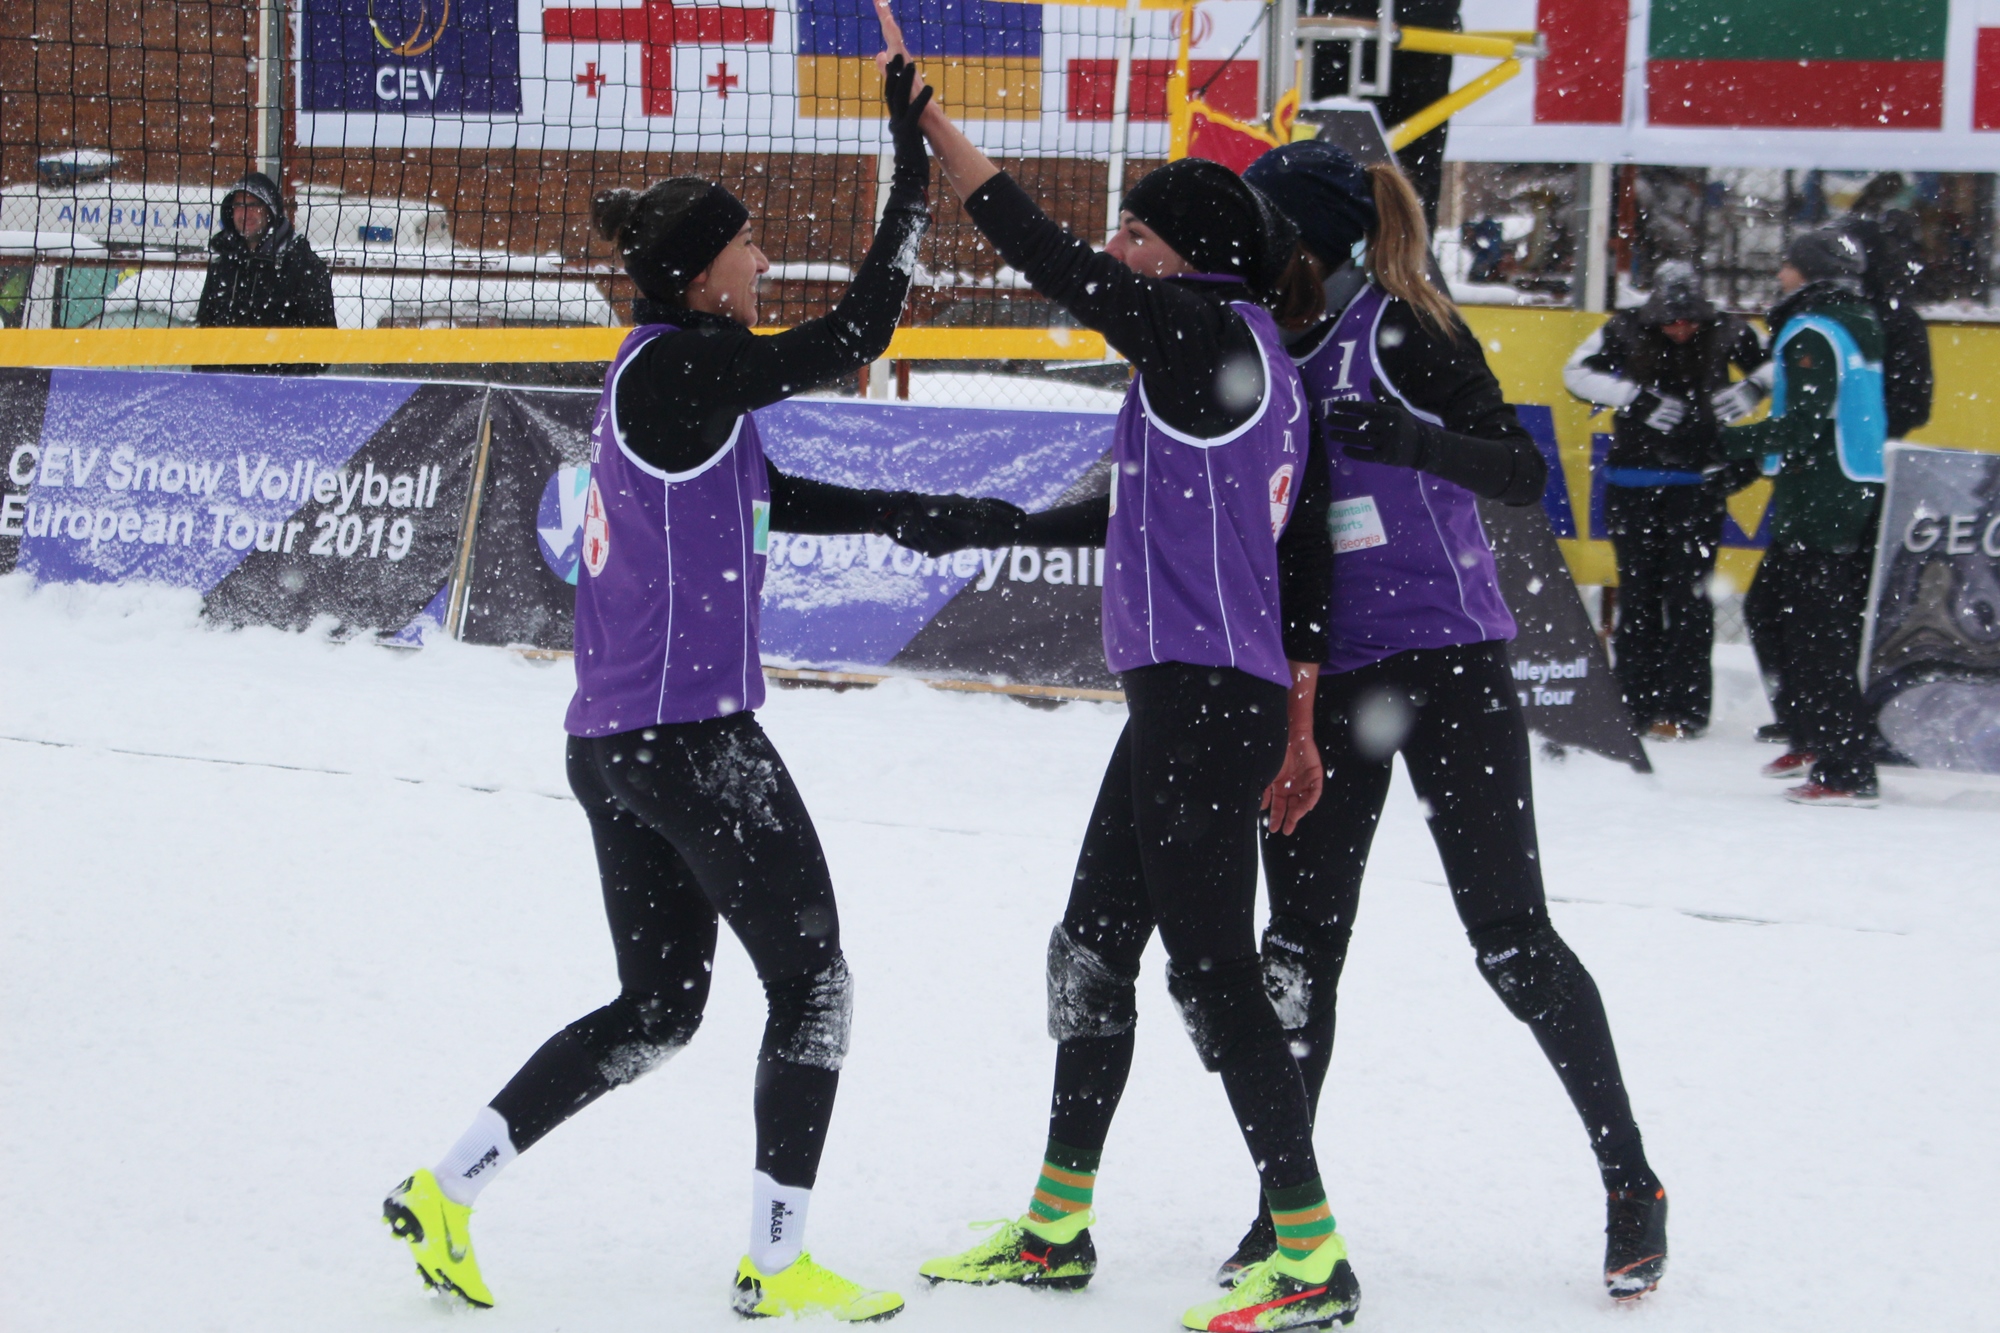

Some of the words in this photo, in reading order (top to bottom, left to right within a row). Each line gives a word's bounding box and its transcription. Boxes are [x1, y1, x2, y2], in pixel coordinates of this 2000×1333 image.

[376, 67, 444, 100] CEV
[58, 205, 225, 230] AMBULAN
[1332, 340, 1357, 390] 1
[8, 443, 100, 488] CEV
[106, 447, 225, 495] Snow
[237, 454, 441, 516] Volleyball
[0, 494, 195, 550] European
[208, 505, 305, 554] Tour
[309, 513, 414, 561] 2019
[1339, 533, 1382, 550] Georgia
[1531, 687, 1576, 706] Tour
